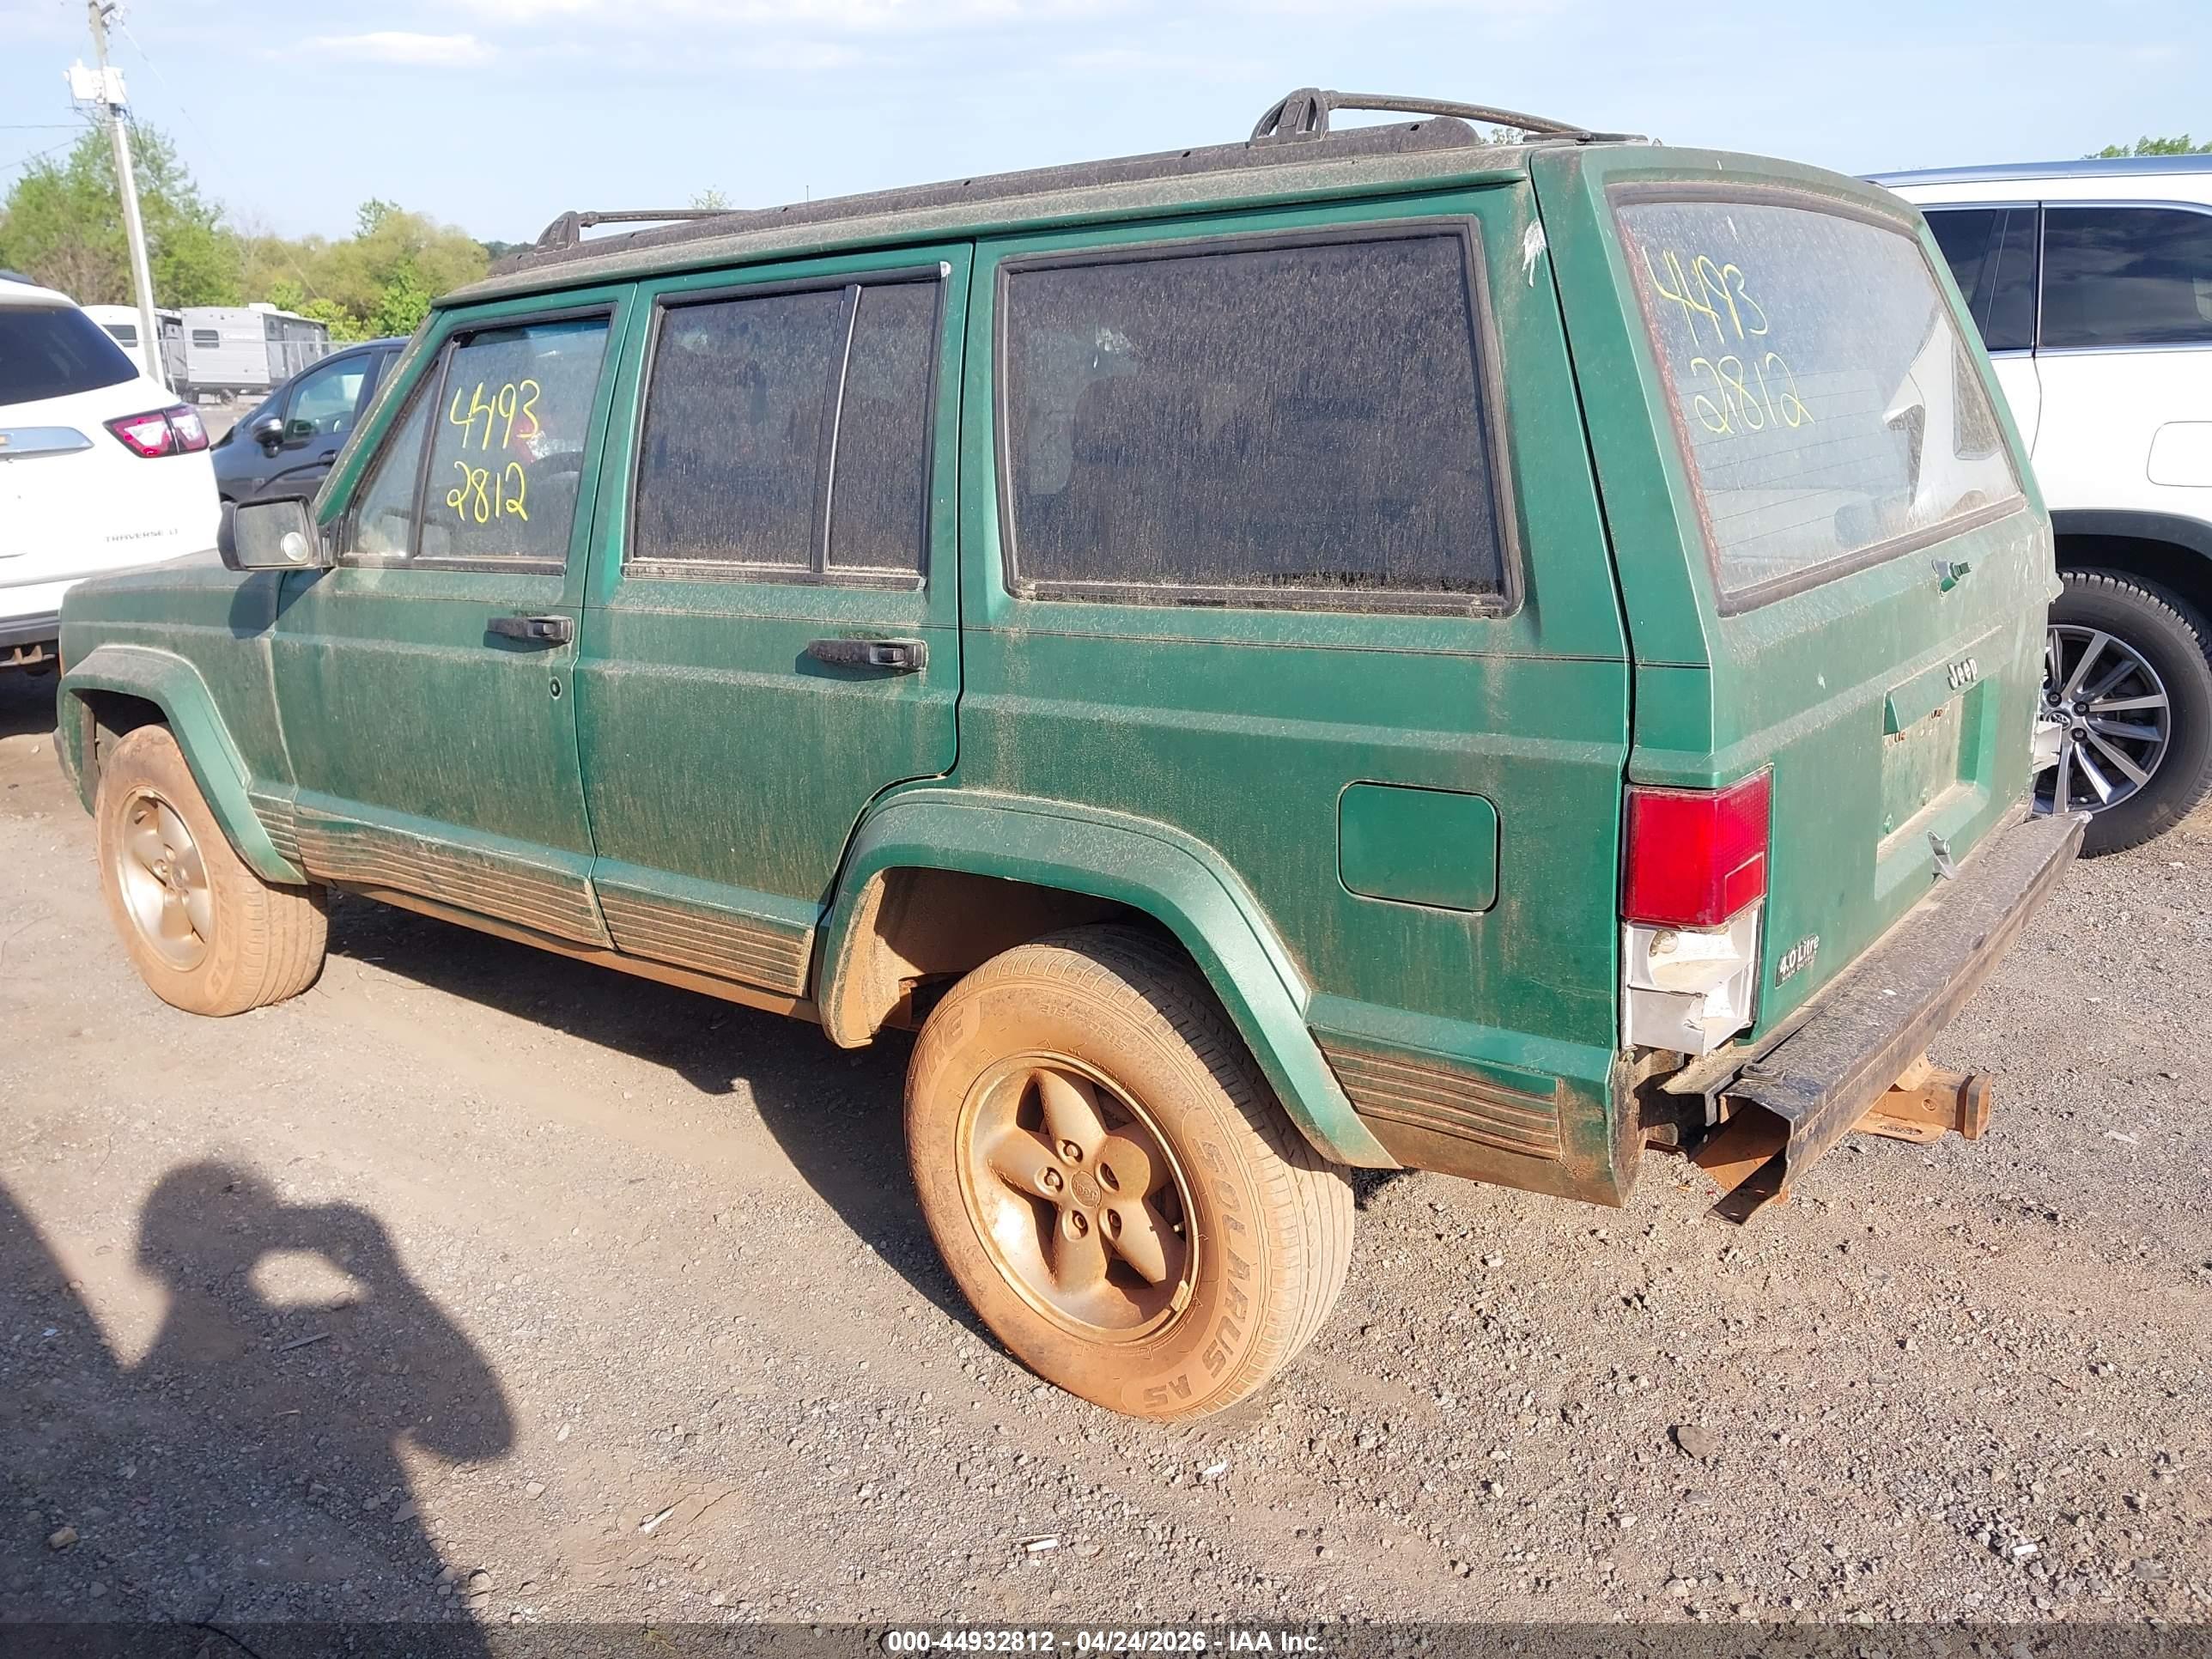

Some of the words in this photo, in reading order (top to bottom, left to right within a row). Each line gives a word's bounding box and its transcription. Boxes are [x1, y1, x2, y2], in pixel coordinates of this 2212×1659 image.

[1641, 246, 1768, 347] 4493
[449, 379, 541, 452] 4493
[1690, 352, 1816, 434] 2812
[446, 460, 529, 523] 2812
[1947, 657, 1978, 690] Jeep
[1797, 935, 1820, 963] Litre
[1191, 1135, 1251, 1379] SOLARUS
[1142, 1373, 1193, 1409] AS
